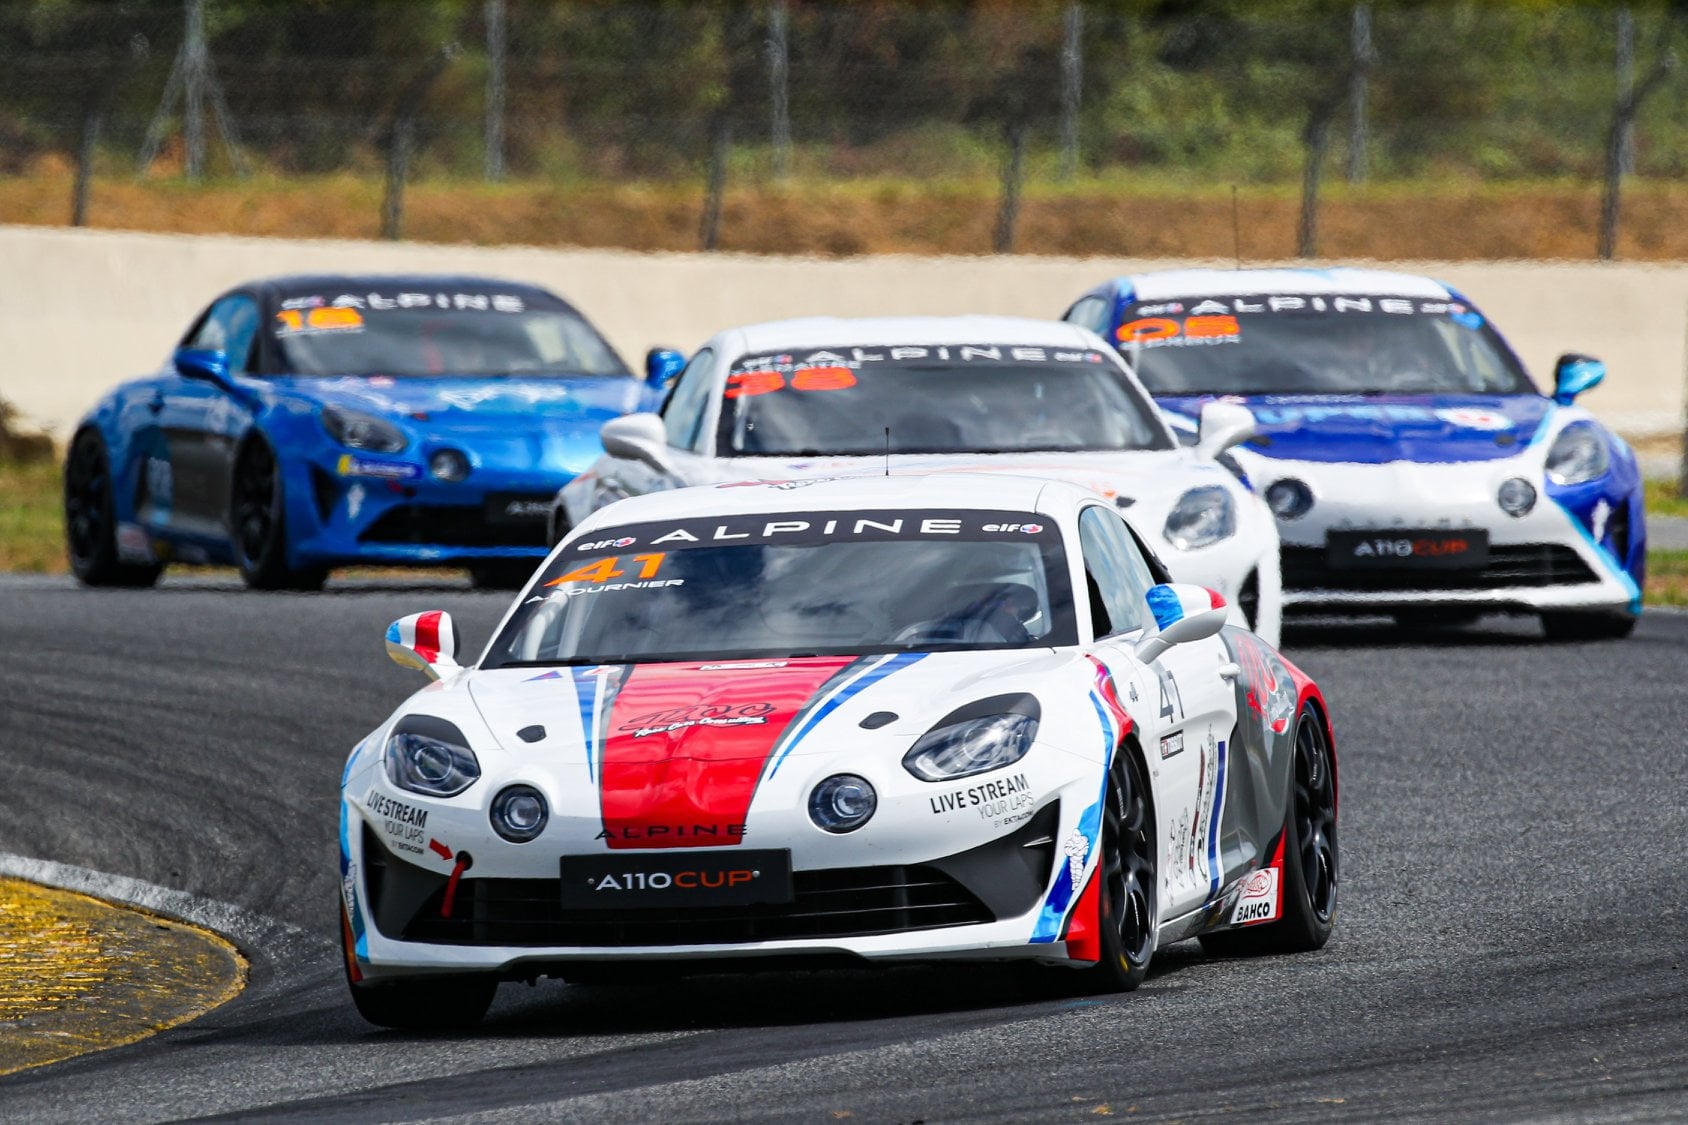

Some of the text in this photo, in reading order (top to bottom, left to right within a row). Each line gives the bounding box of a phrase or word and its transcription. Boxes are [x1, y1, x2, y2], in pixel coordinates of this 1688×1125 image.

[332, 292, 525, 312] ALPINE
[1190, 297, 1414, 315] ALPINE
[805, 348, 1047, 362] ALPINE
[650, 519, 962, 545] ALPINE
[981, 523, 1021, 533] elf
[577, 539, 614, 551] elf
[543, 552, 667, 588] 41
[525, 579, 685, 604] A.OURNIER
[1159, 670, 1185, 723] 41
[931, 773, 1030, 814] LIVE STREAM
[367, 790, 428, 828] LIVE STREAM
[976, 791, 1034, 820] YOUR LAPS
[384, 819, 424, 844] YOUR LAPS
[594, 824, 749, 840] ALPINE
[595, 870, 753, 891] A110CUP
[1236, 901, 1271, 922] BAHCO
